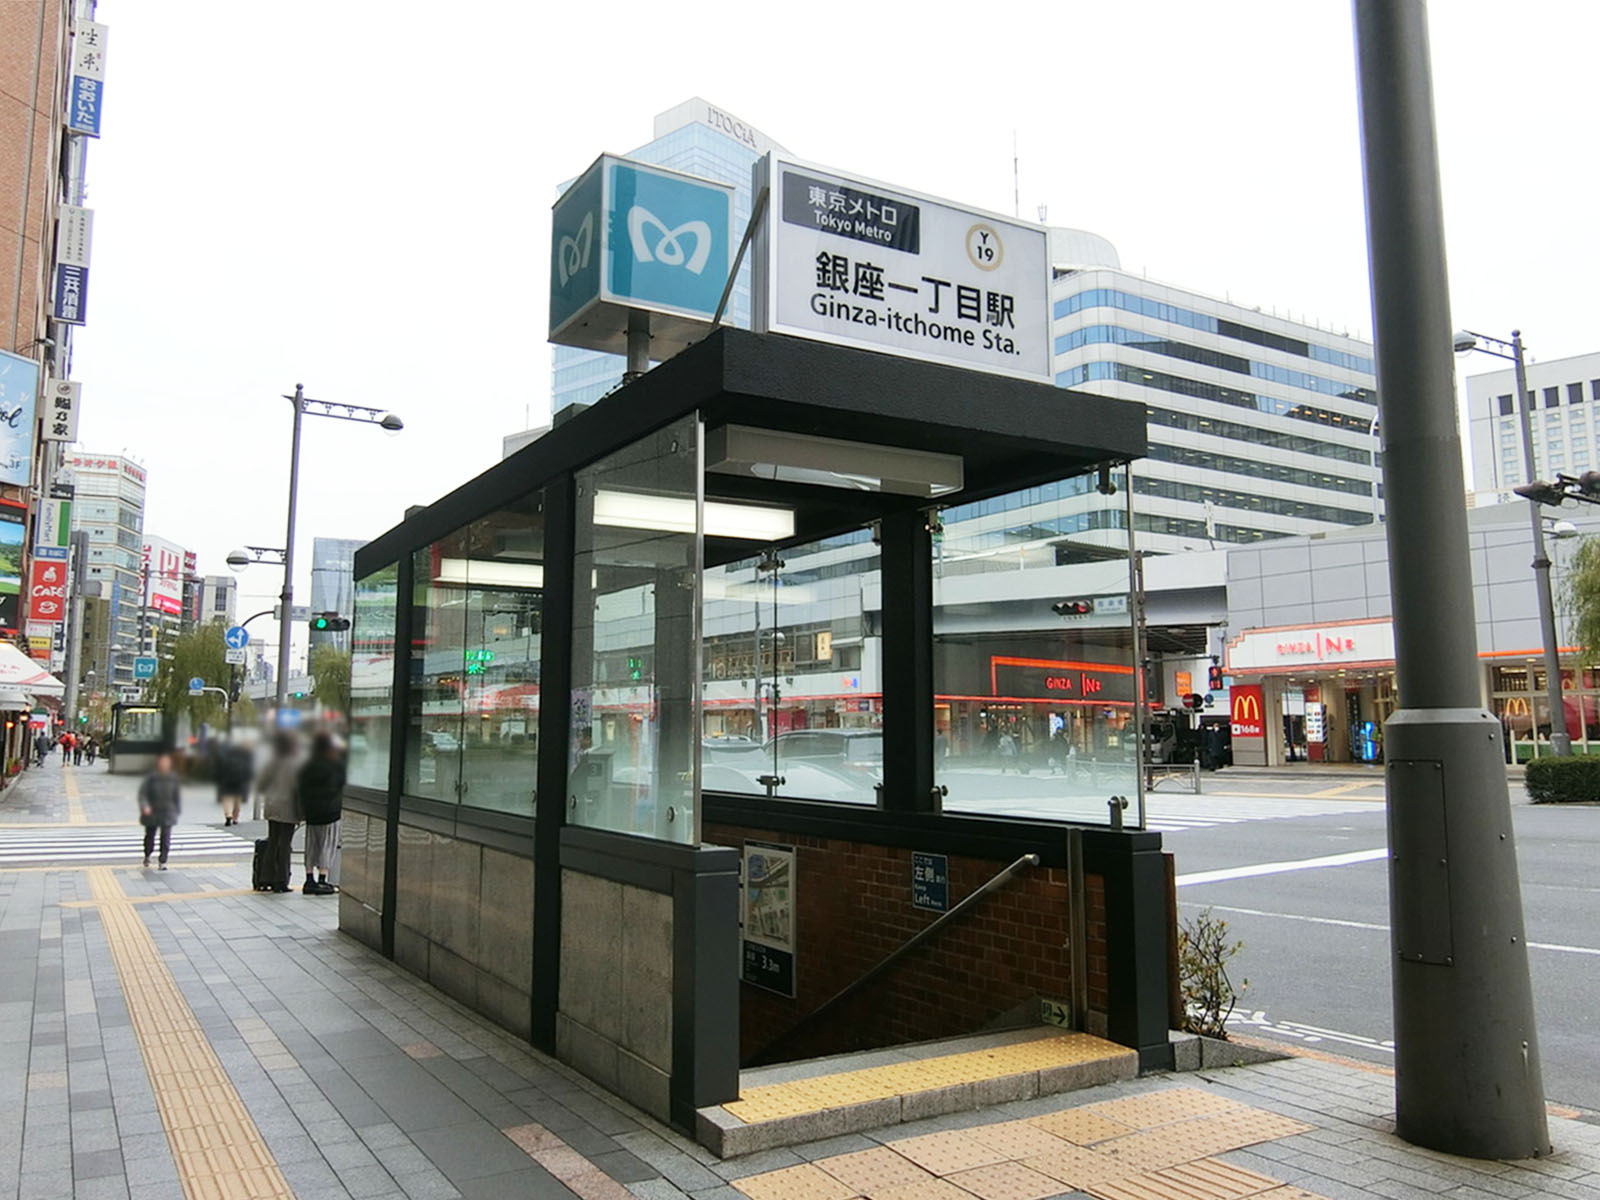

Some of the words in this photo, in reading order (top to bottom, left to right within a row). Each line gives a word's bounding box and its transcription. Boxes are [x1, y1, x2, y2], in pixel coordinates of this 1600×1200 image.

[76, 78, 97, 124] おおいた
[808, 185, 897, 226] 東京メトロ
[814, 209, 851, 232] Tokyo
[855, 220, 892, 243] Metro
[980, 231, 990, 245] Y
[977, 245, 995, 263] 19
[815, 250, 1015, 330] 銀座一丁目駅
[810, 292, 975, 347] Ginza-itchome
[983, 328, 1021, 356] Sta.
[1046, 676, 1072, 690] GINZA
[914, 893, 930, 905] Left
